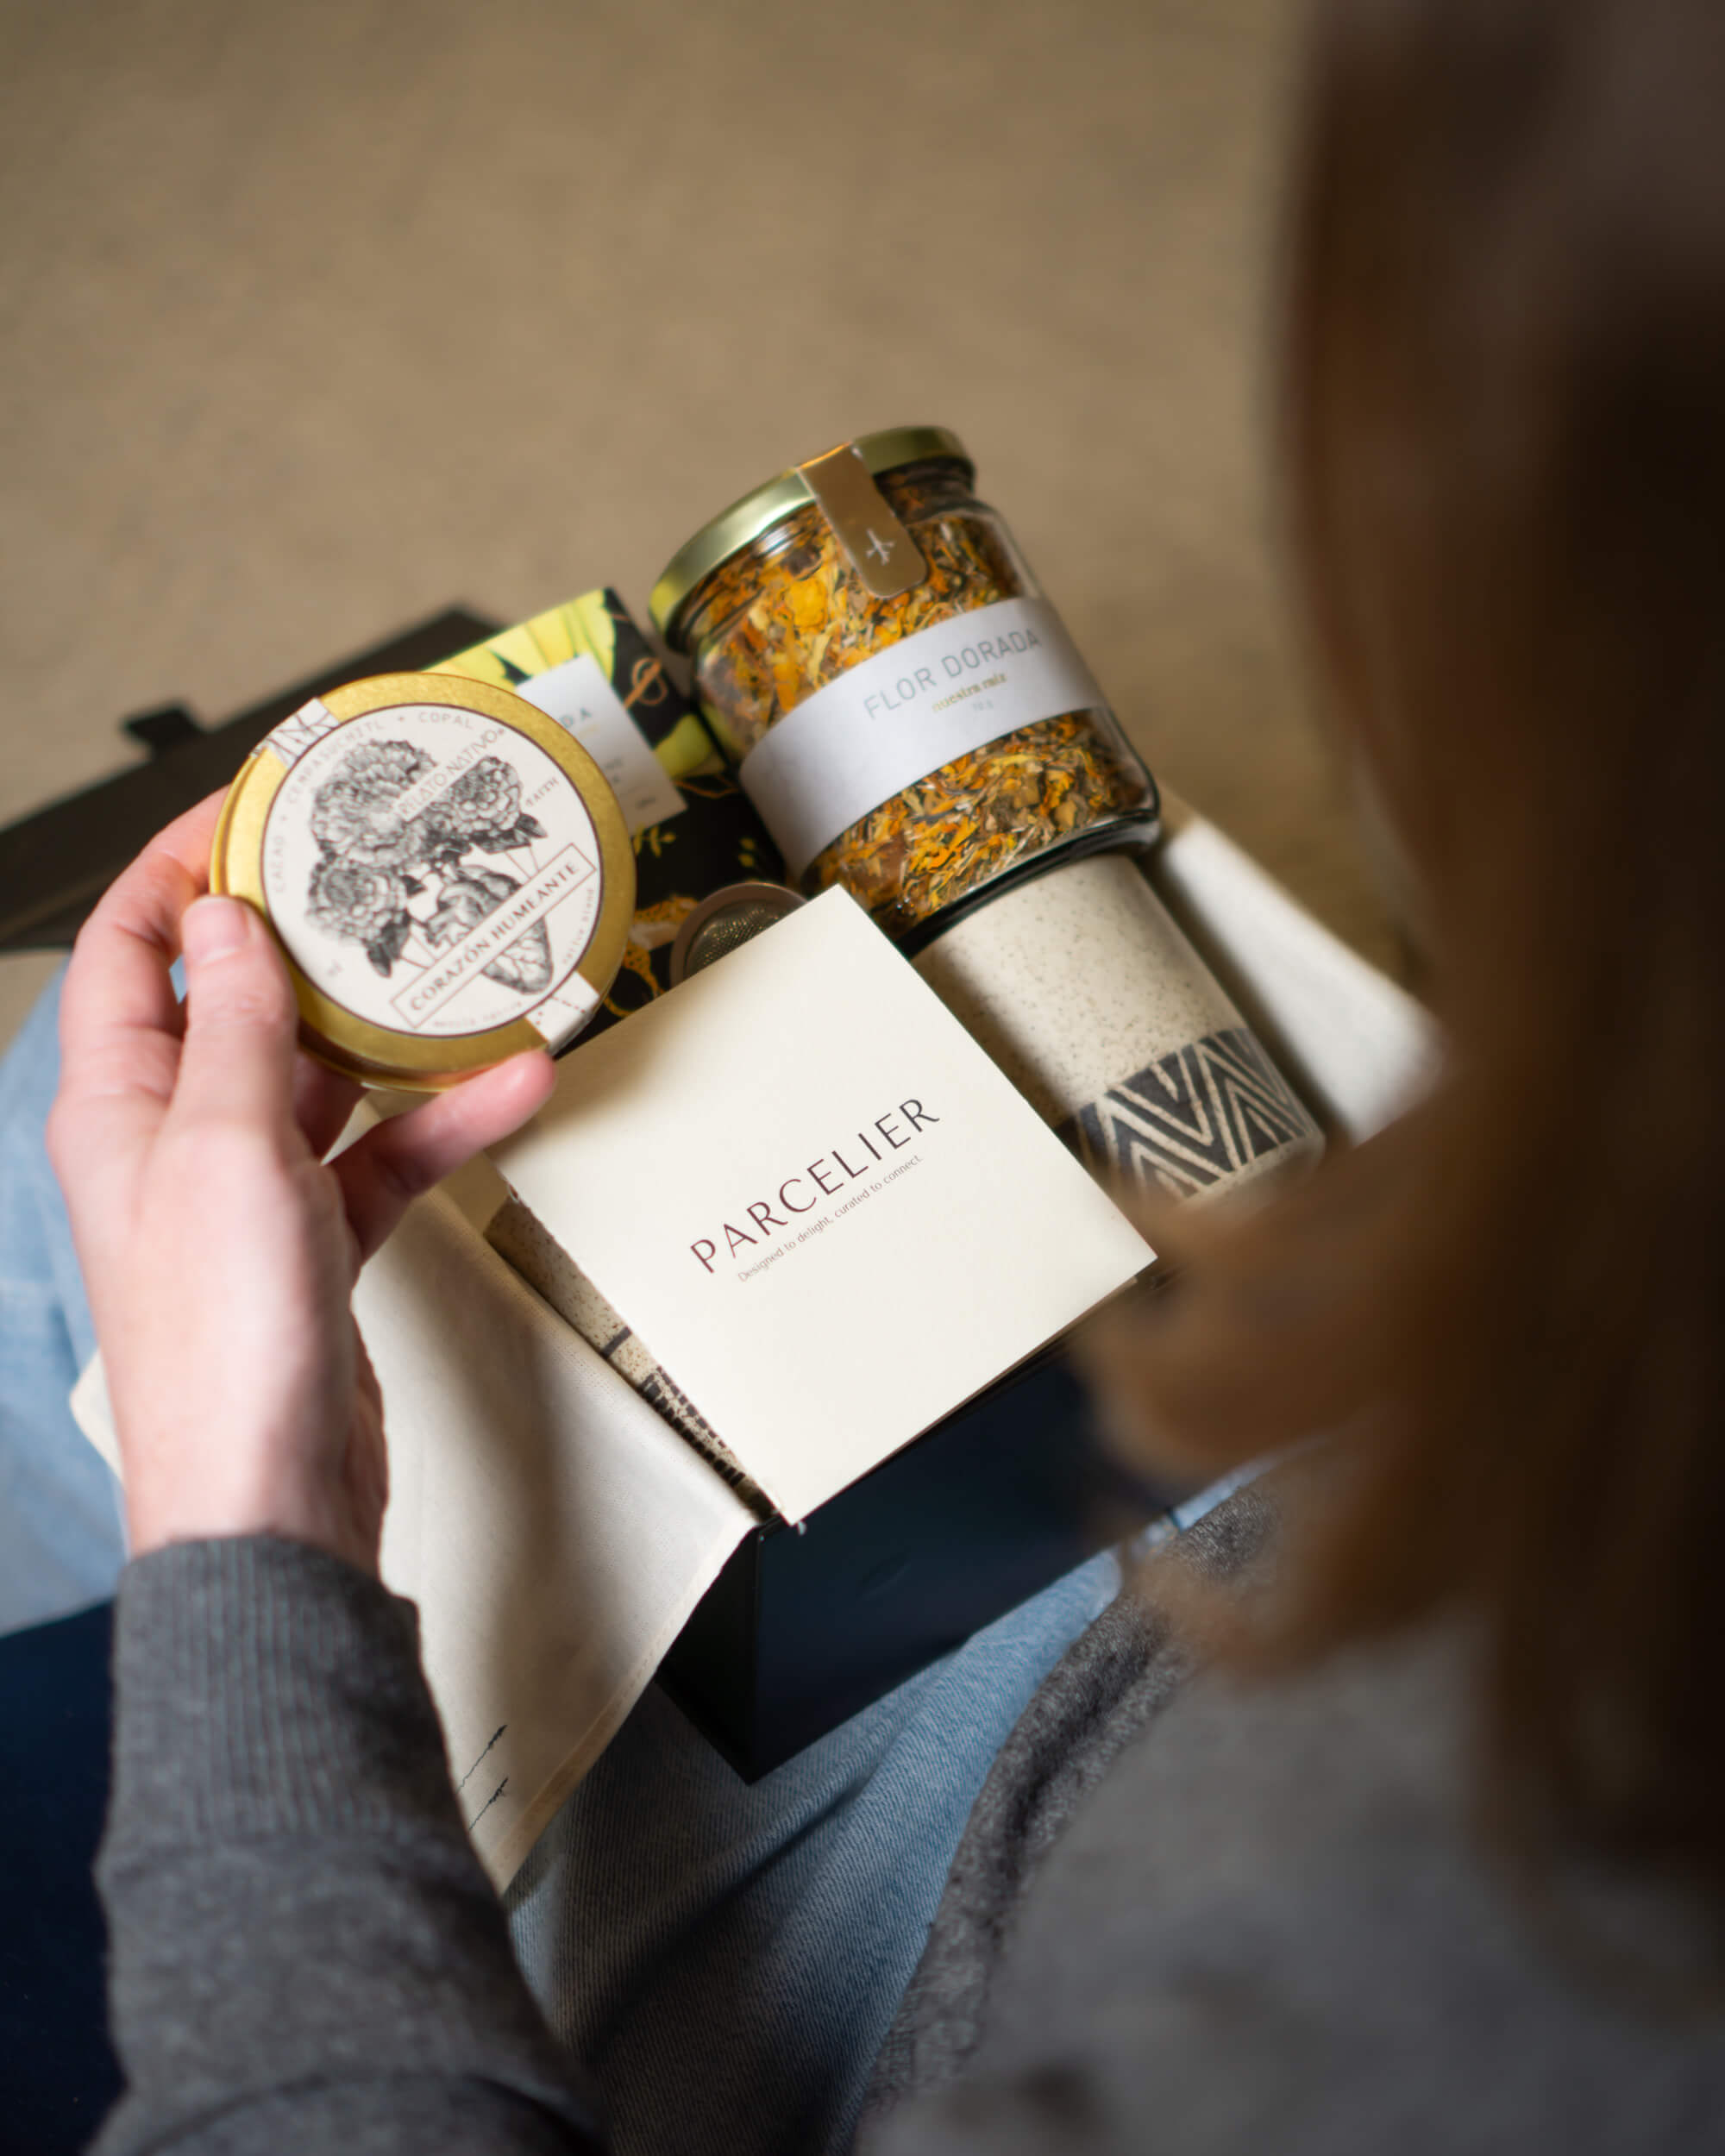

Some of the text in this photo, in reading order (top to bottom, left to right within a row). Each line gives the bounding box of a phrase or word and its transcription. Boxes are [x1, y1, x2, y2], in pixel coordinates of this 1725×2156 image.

[419, 711, 474, 730] COPAL
[863, 628, 1042, 719] FLOR DORADA
[398, 730, 498, 814] RELATO NATIVO
[411, 862, 579, 1011] CORAZÓN HUMEANTE
[690, 1099, 940, 1274] PARCELIER
[737, 1247, 785, 1282] Designed
[783, 1241, 797, 1250] to
[797, 1216, 834, 1243] delight,
[834, 1188, 870, 1218] curated
[869, 1181, 882, 1193] to
